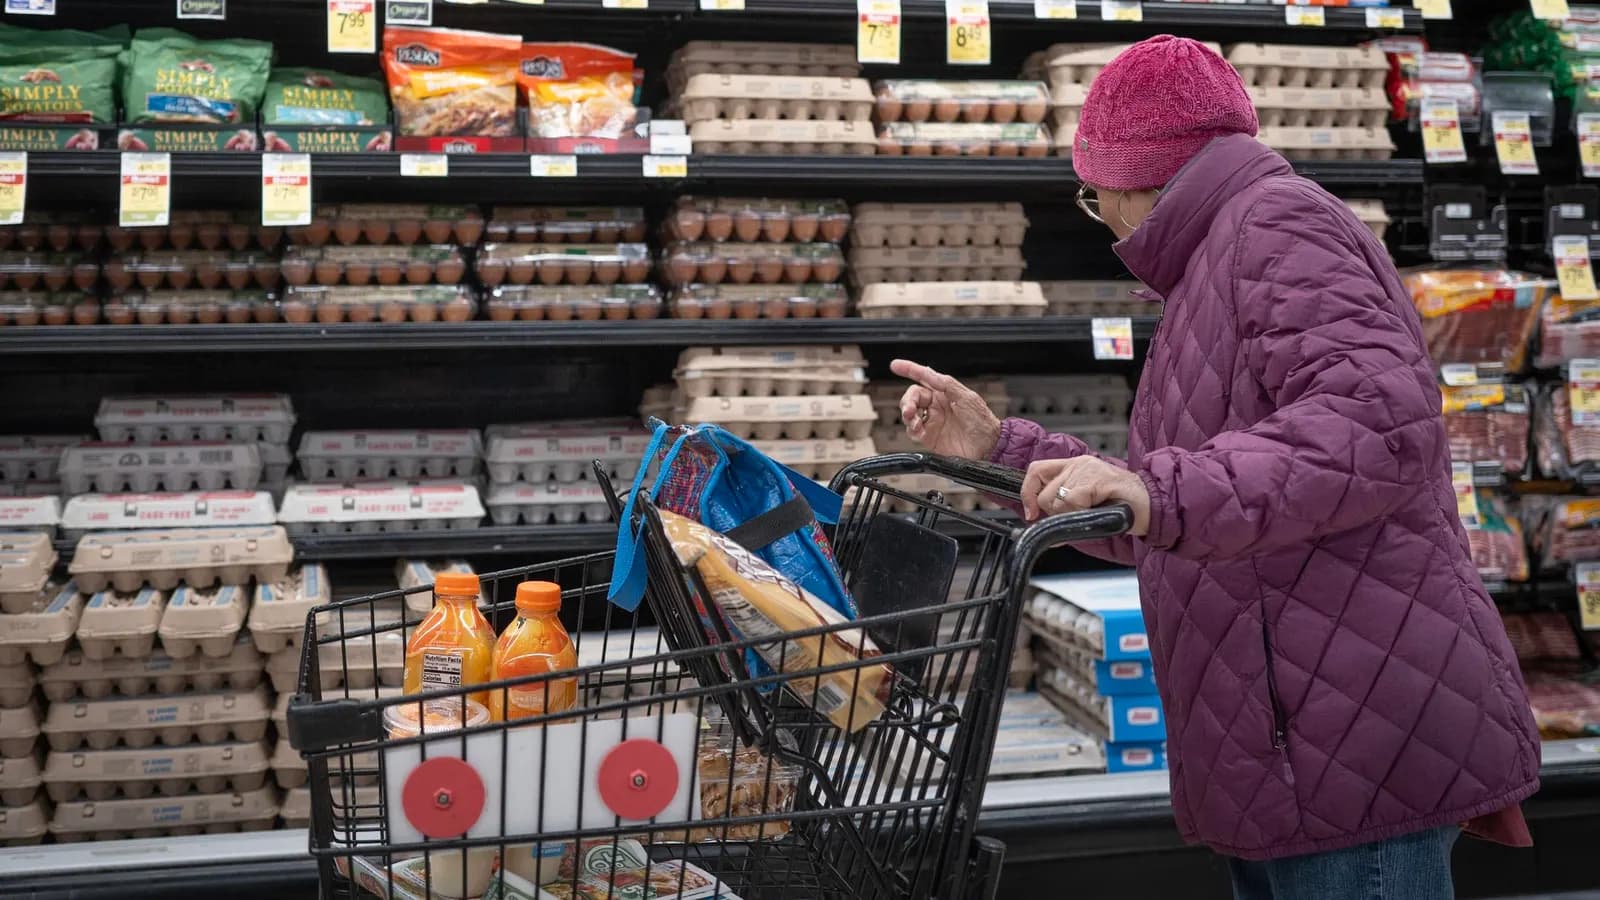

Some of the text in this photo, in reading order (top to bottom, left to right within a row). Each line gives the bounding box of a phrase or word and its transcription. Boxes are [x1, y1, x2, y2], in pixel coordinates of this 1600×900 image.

[156, 68, 233, 90] SIMPLY
[0, 84, 81, 101] SIMPLY
[155, 82, 231, 100] POTATOES
[282, 85, 354, 102] SIMPLY
[4, 100, 83, 113] POTATOES
[0, 129, 58, 142] IMPLY
[154, 130, 218, 144] SIMPLY
[297, 131, 360, 145] SIMPLY
[155, 142, 219, 152] POTATOES
[298, 143, 361, 153] POTATOES
[139, 510, 192, 520] CAGE-FREE
[447, 656, 461, 664] Facts
[424, 674, 460, 684] Calories 120
